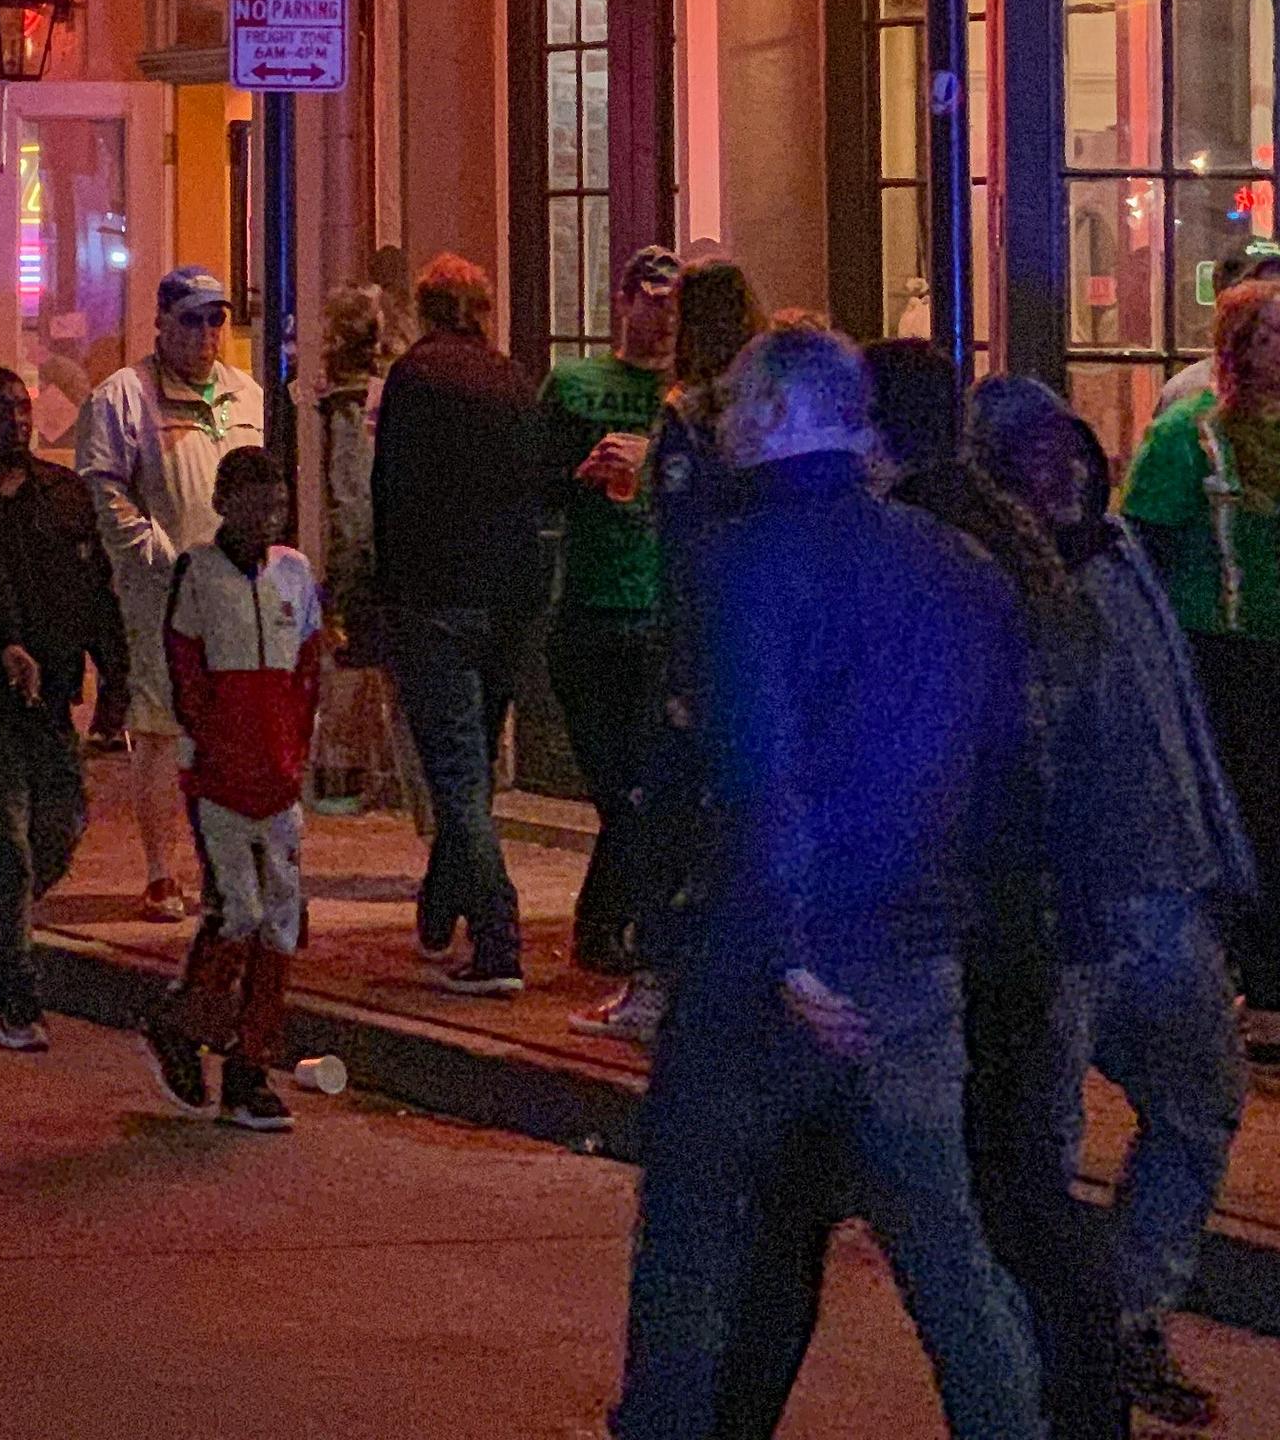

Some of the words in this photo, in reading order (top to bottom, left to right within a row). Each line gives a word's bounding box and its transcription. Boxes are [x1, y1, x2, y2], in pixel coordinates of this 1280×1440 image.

[236, 0, 266, 20] NO
[271, 0, 338, 20] PARKING
[246, 30, 297, 44] FREIGHT
[300, 30, 335, 45] ZONE
